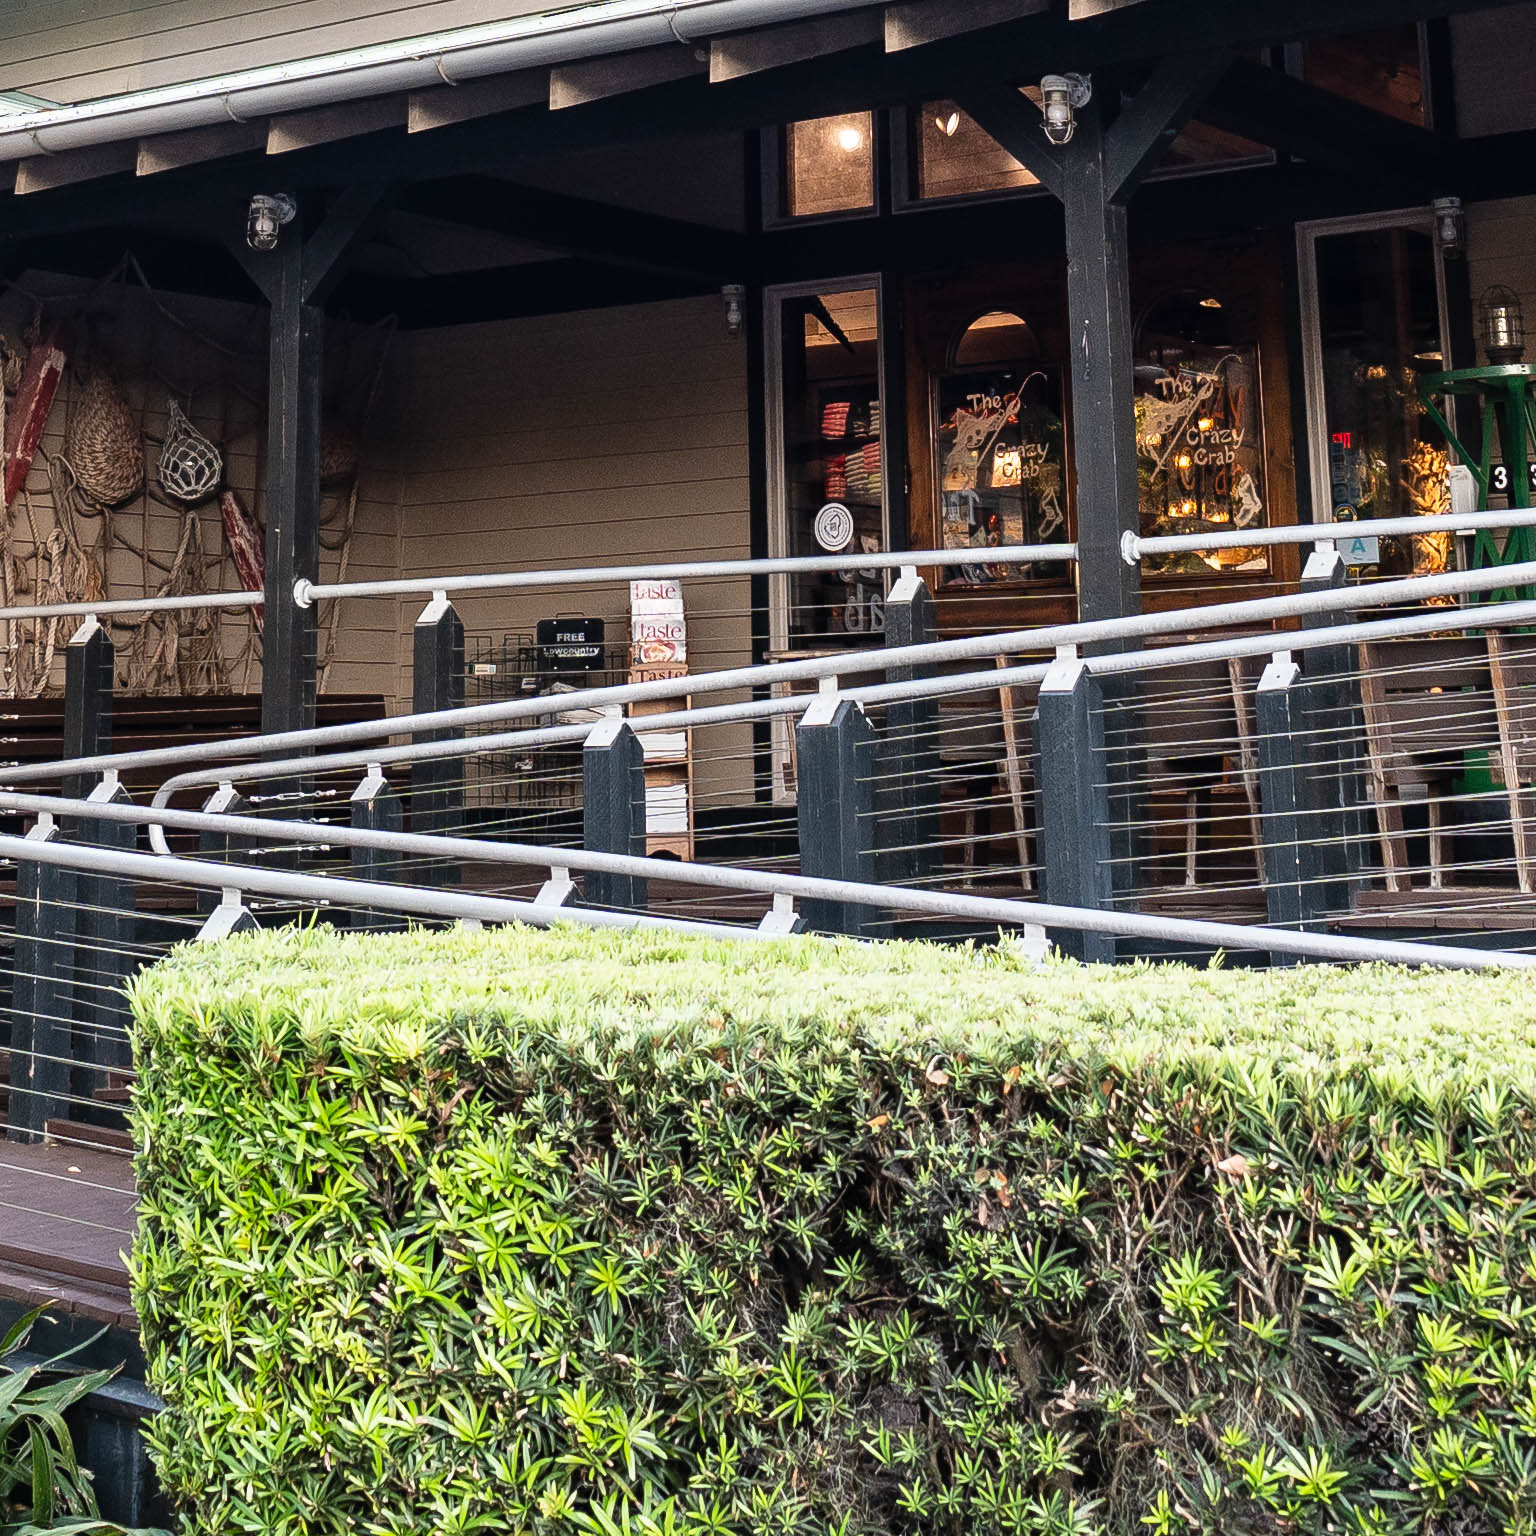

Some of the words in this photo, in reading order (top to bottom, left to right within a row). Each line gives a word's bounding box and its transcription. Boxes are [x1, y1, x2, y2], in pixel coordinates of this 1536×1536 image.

[1155, 375, 1193, 397] The
[966, 393, 1002, 413] The
[1186, 427, 1246, 450] Crazy
[994, 442, 1050, 463] Crazy
[1194, 446, 1236, 466] Crab
[1351, 537, 1367, 553] A
[634, 583, 676, 600] taste
[556, 632, 585, 642] FREE
[640, 623, 682, 639] taste
[543, 646, 601, 657] Lowcountry
